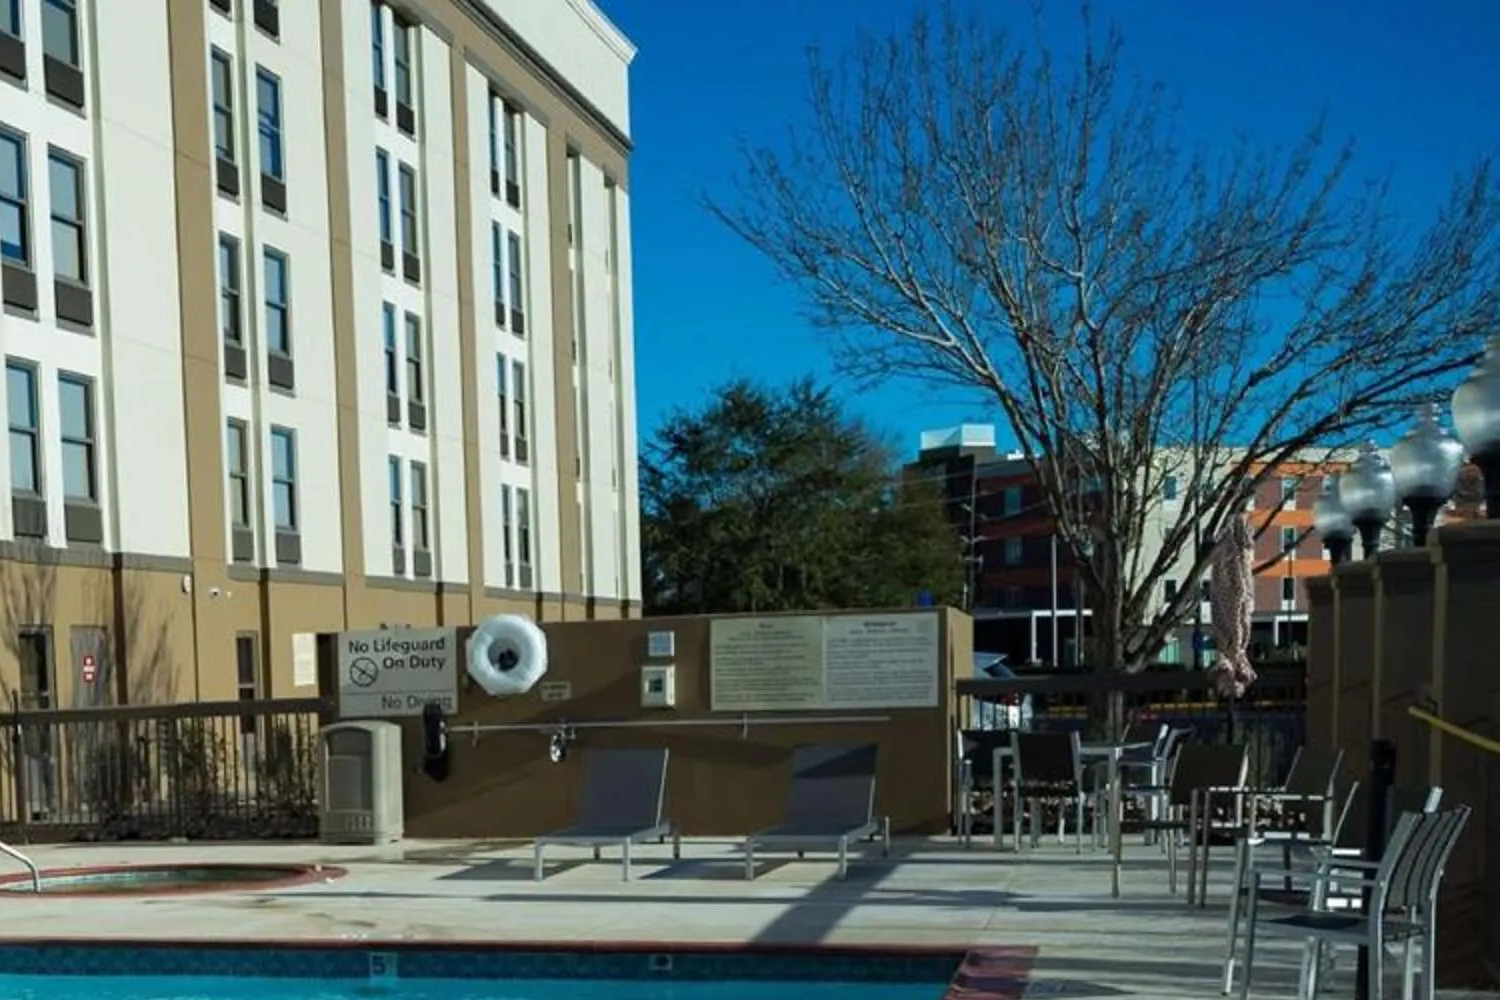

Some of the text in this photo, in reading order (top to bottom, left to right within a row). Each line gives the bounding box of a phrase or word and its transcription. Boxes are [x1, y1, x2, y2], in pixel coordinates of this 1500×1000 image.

[348, 636, 445, 655] No Lifeguard
[383, 655, 447, 670] On Duty
[381, 695, 402, 710] No
